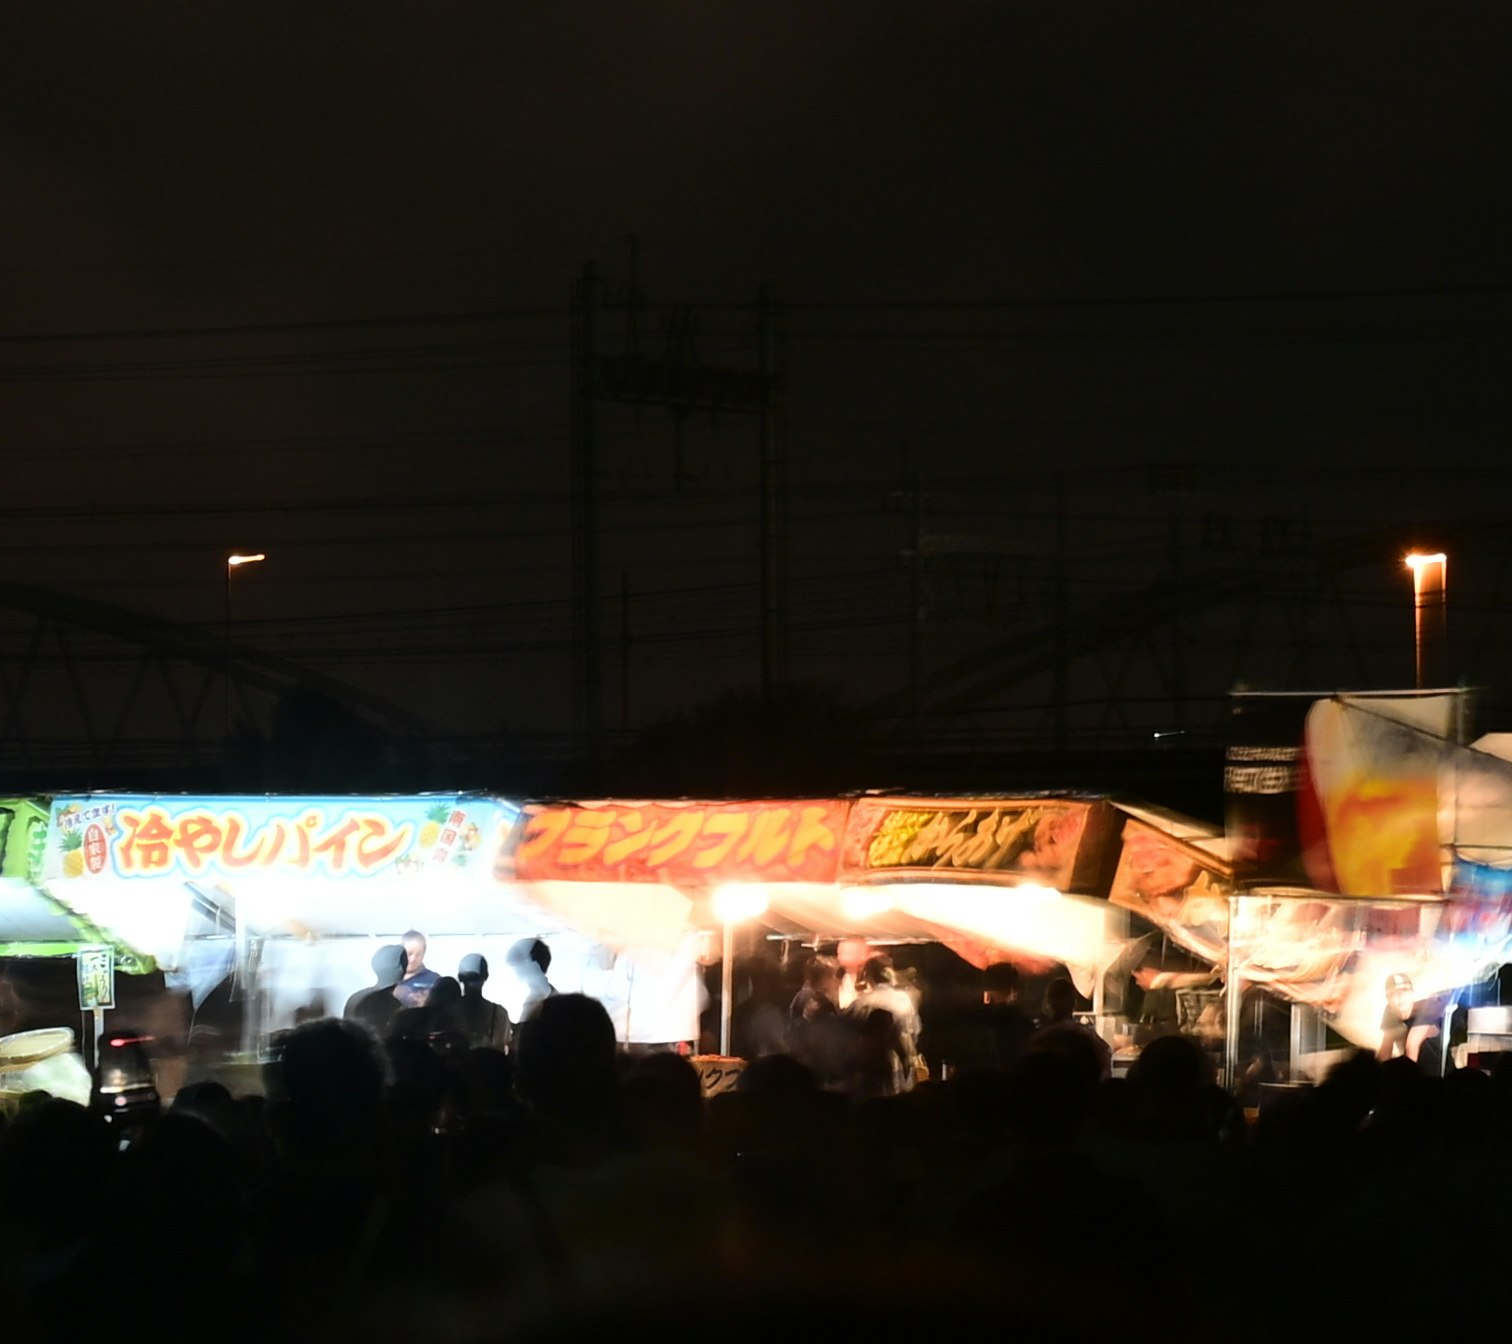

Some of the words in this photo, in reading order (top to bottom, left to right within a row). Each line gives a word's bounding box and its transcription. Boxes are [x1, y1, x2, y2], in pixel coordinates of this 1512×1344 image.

[120, 809, 410, 871] 冷やしパイン
[517, 806, 839, 869] フランクフルト
